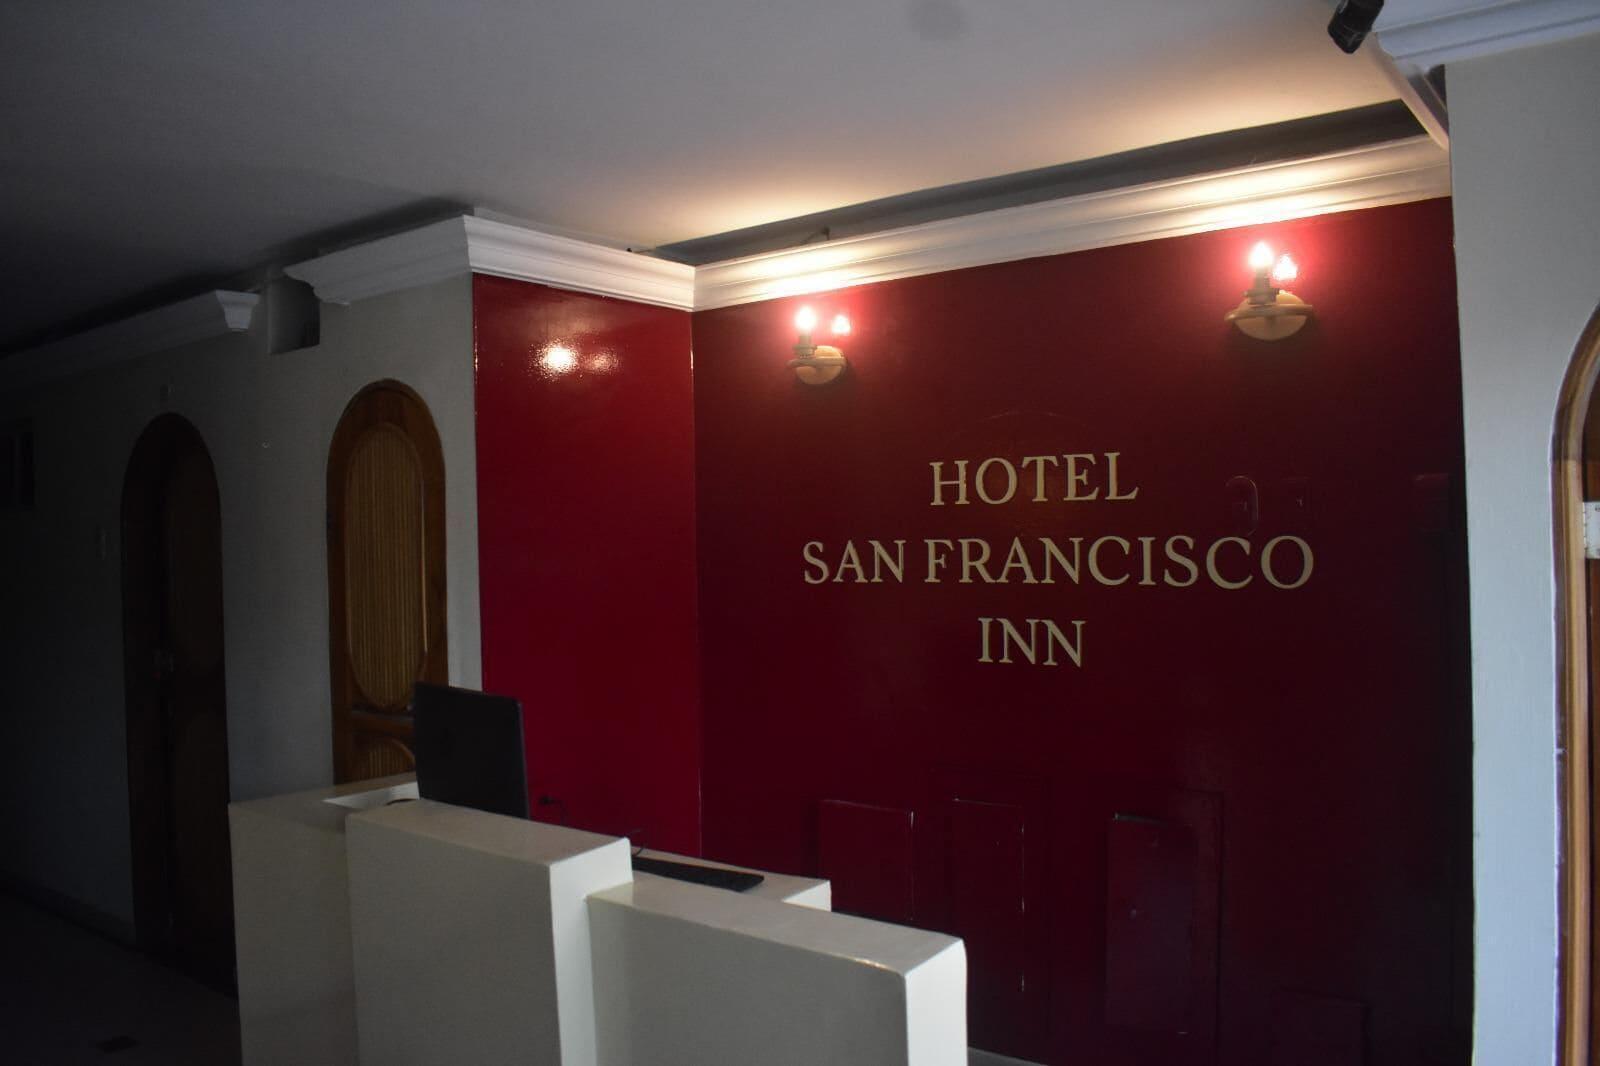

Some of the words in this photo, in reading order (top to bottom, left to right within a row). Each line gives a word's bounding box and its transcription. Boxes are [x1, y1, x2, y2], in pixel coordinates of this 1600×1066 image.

[930, 452, 1138, 506] HOTEL
[803, 539, 906, 585] SAN
[924, 536, 1314, 589] FRANCISCO
[978, 617, 1086, 667] INN
